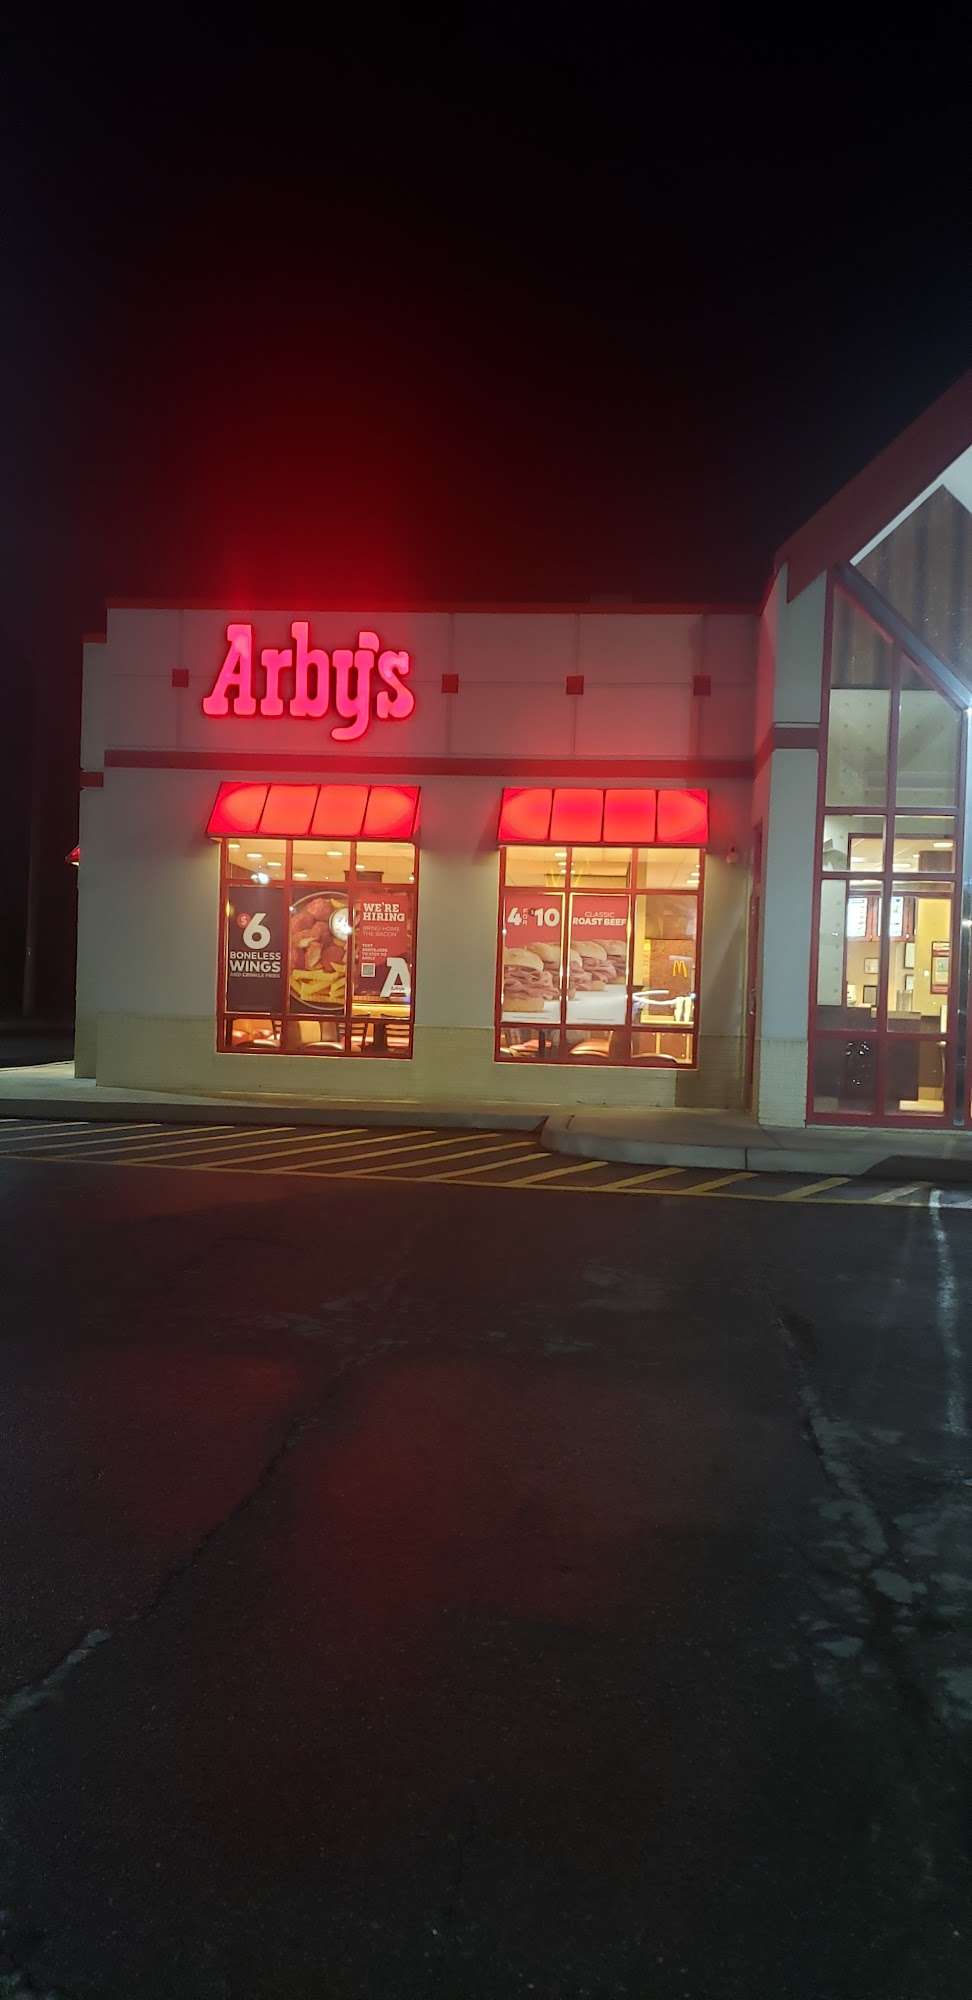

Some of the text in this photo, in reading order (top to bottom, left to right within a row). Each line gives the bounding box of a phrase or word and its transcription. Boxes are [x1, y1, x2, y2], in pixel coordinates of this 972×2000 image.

[202, 620, 415, 741] Arby's
[362, 902, 400, 913] WE'RE
[362, 912, 405, 922] HIRING
[507, 907, 522, 926] 4
[572, 917, 627, 926] ROAST BEEF
[229, 951, 281, 960] BONELESS
[229, 960, 281, 973] WINGS
